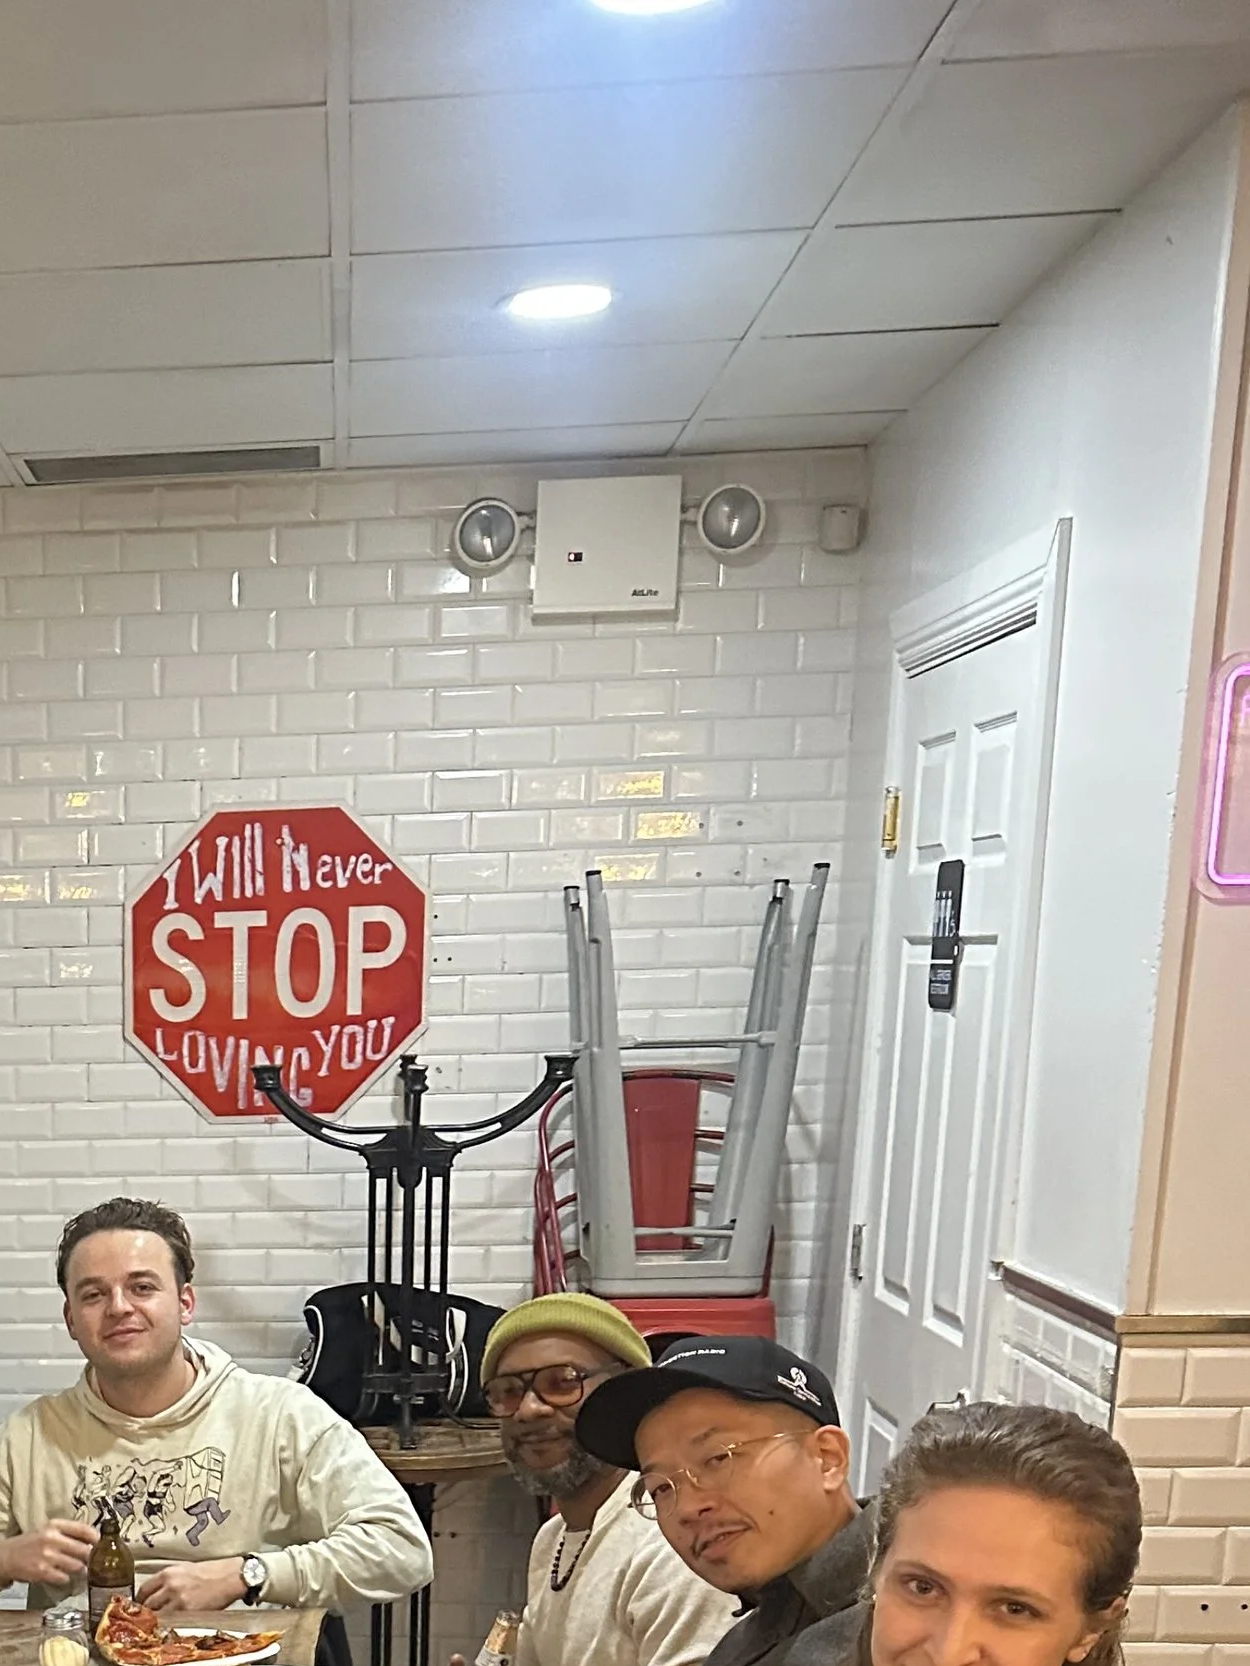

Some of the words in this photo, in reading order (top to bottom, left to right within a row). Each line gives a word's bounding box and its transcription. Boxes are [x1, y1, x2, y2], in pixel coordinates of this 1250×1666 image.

[162, 858, 182, 910] I
[149, 904, 407, 1023] STOP
[311, 1016, 396, 1077] YOU
